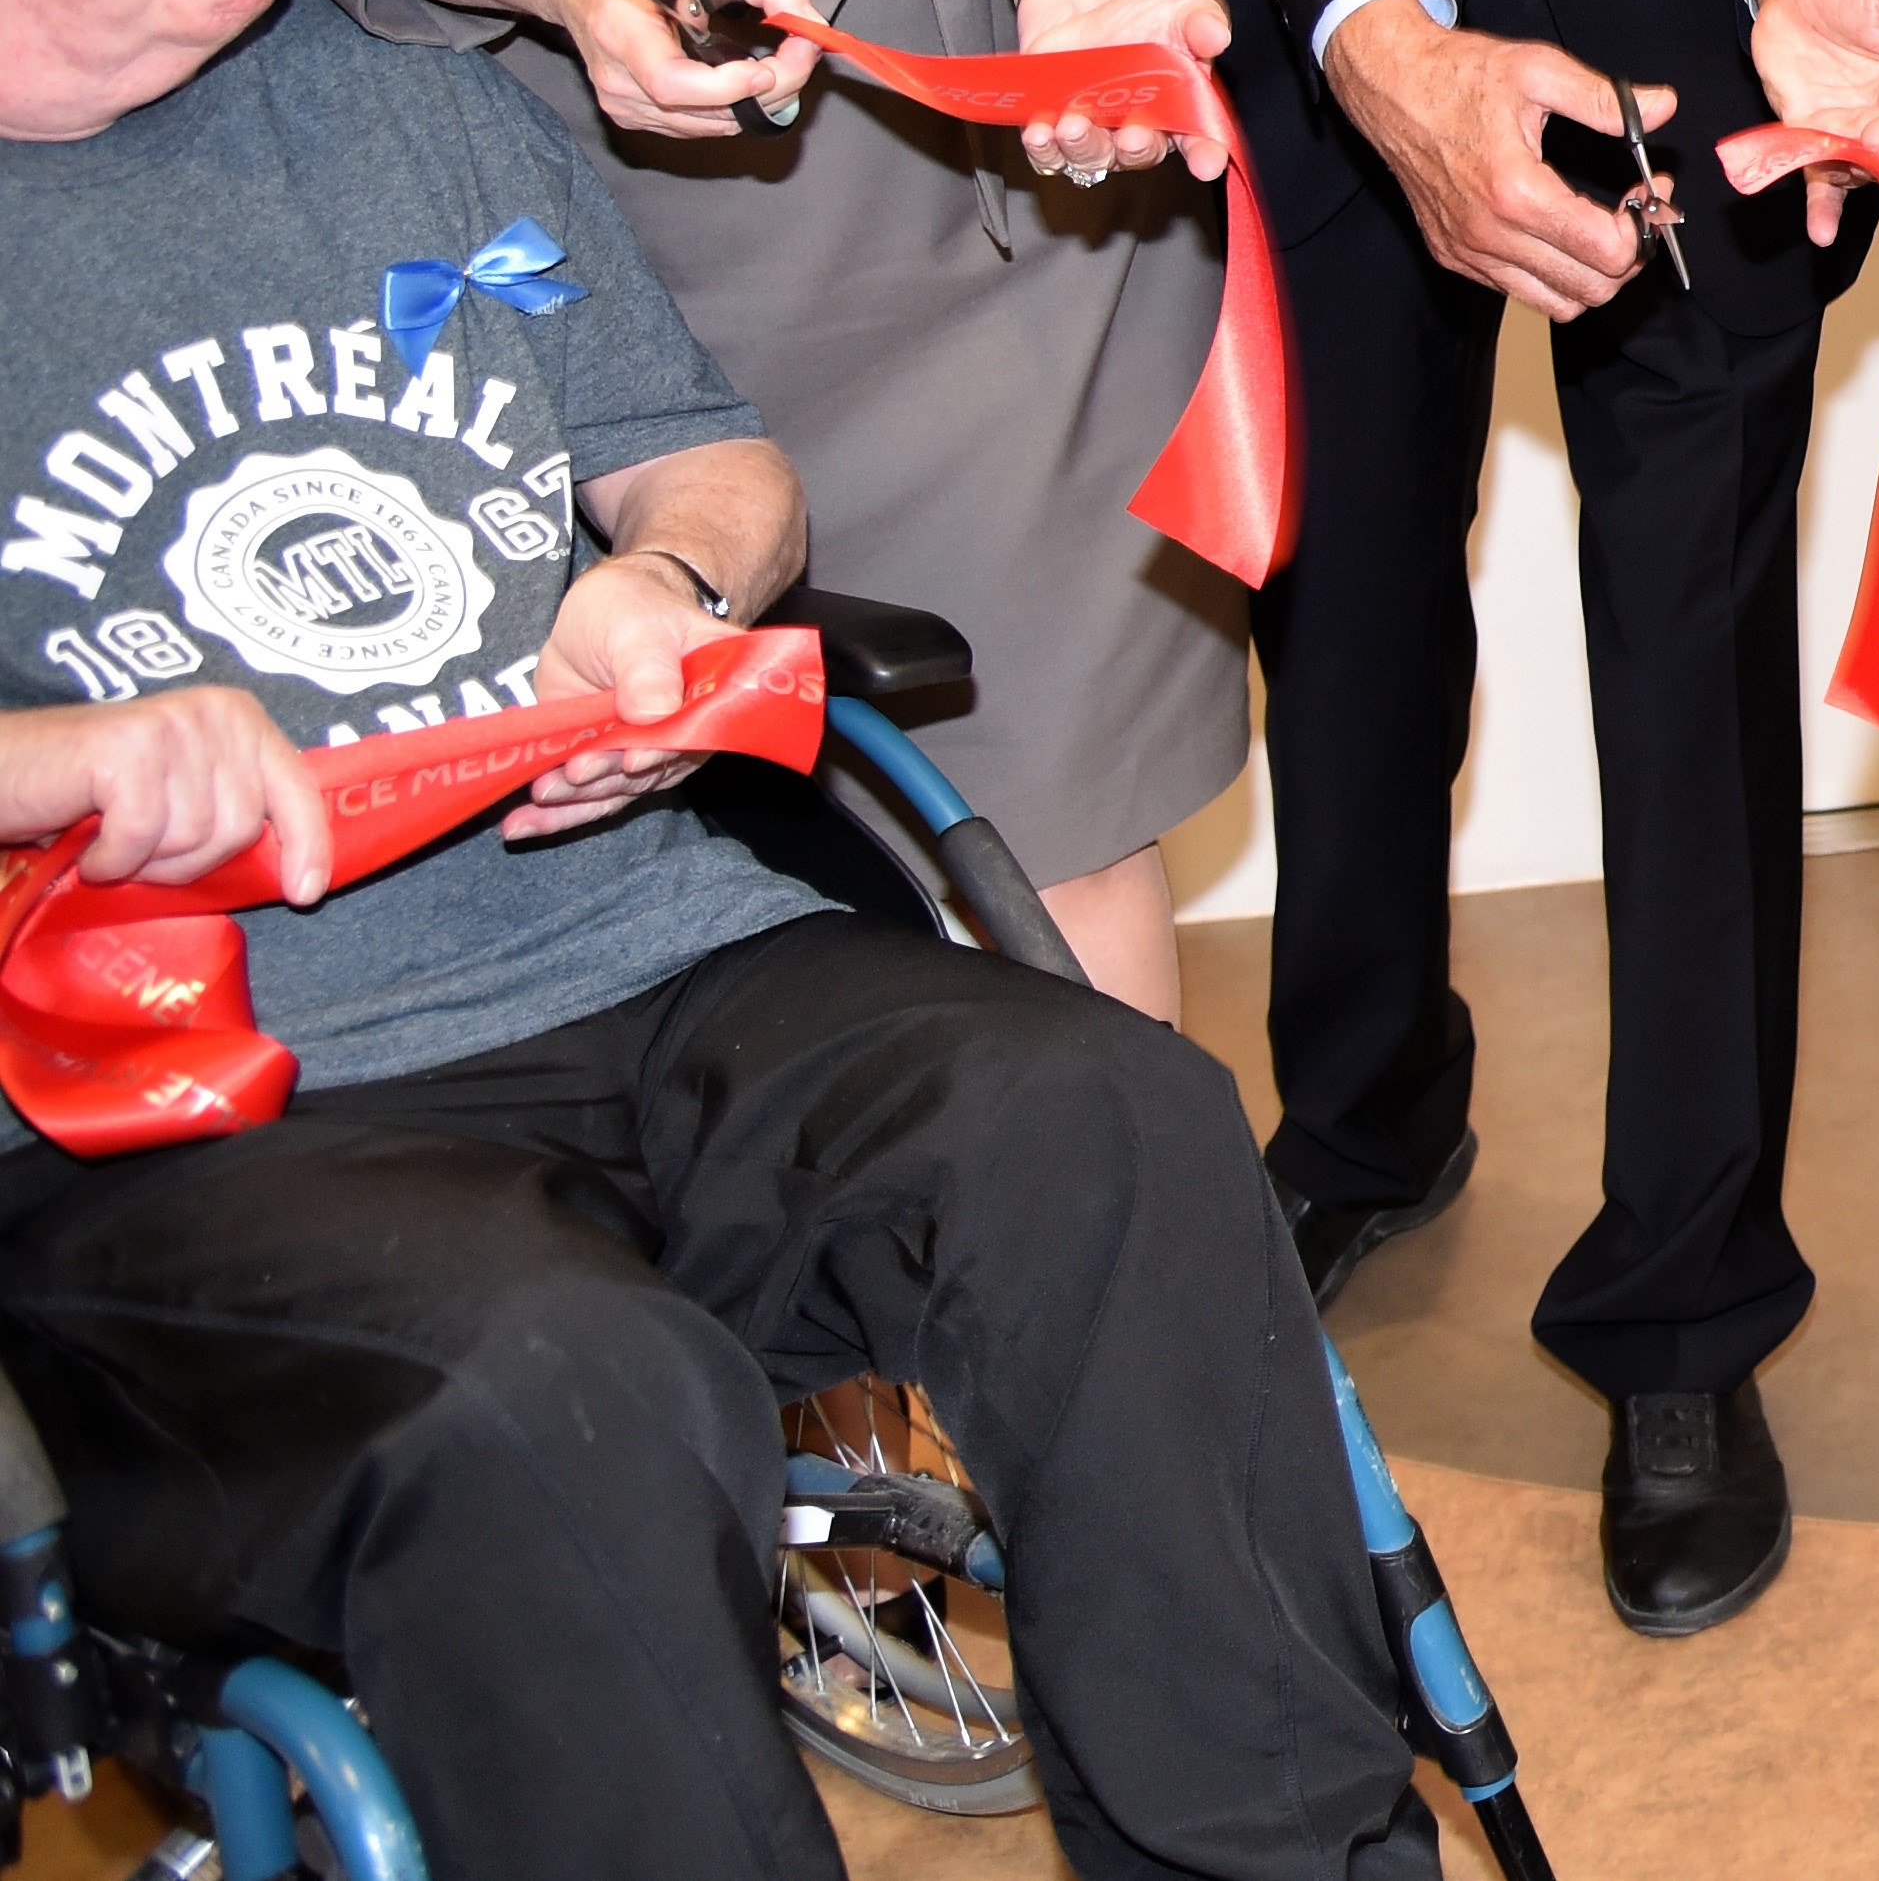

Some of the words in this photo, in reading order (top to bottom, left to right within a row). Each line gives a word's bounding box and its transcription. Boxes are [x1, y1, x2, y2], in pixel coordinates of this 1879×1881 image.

[1066, 85, 1161, 110] COS
[1, 321, 517, 601] MONTRÉAL
[273, 479, 363, 506] SINCE
[210, 500, 267, 590] CANADA
[372, 502, 434, 555] 1867
[46, 609, 204, 703] 18
[468, 452, 573, 561] 67
[254, 524, 415, 620] MTL
[411, 563, 453, 642] CANADA
[233, 603, 305, 649] 1867
[317, 638, 410, 661] SINCE
